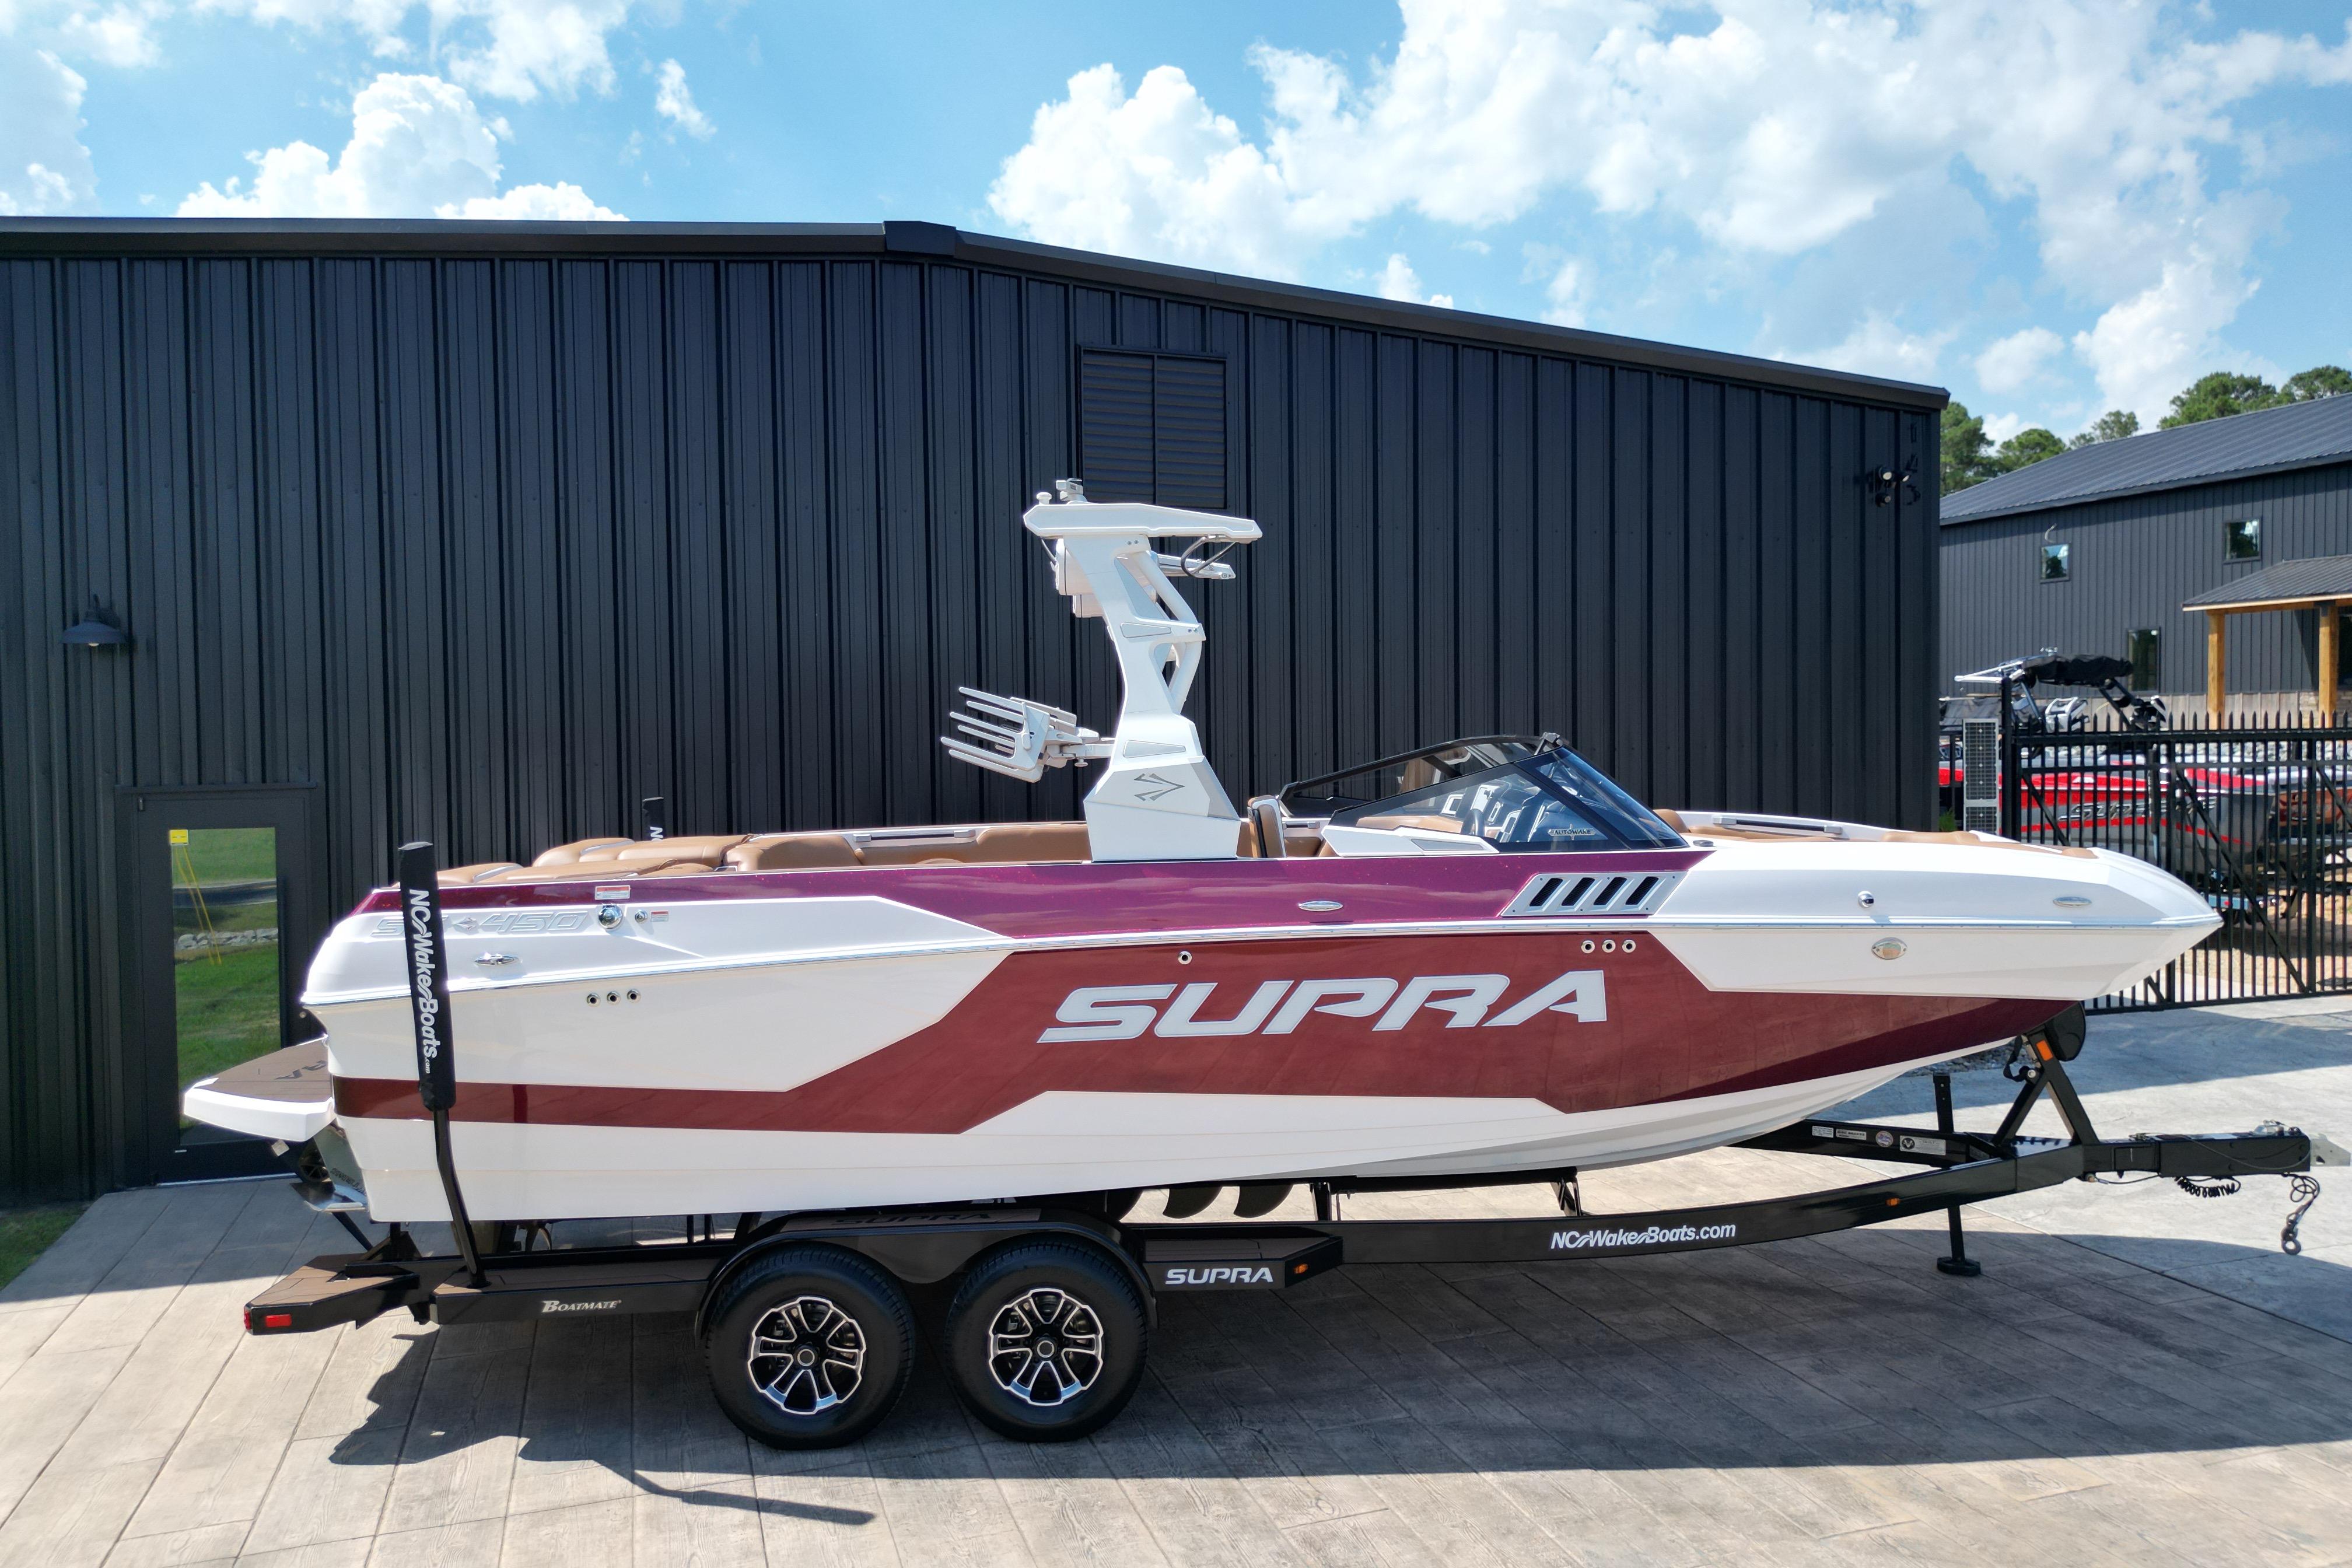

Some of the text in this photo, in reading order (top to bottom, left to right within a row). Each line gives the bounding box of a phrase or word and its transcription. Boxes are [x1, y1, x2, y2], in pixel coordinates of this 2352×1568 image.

[478, 911, 588, 933] 450
[1036, 970, 1608, 1044] SUPRA
[1164, 1267, 1274, 1284] SUPRA
